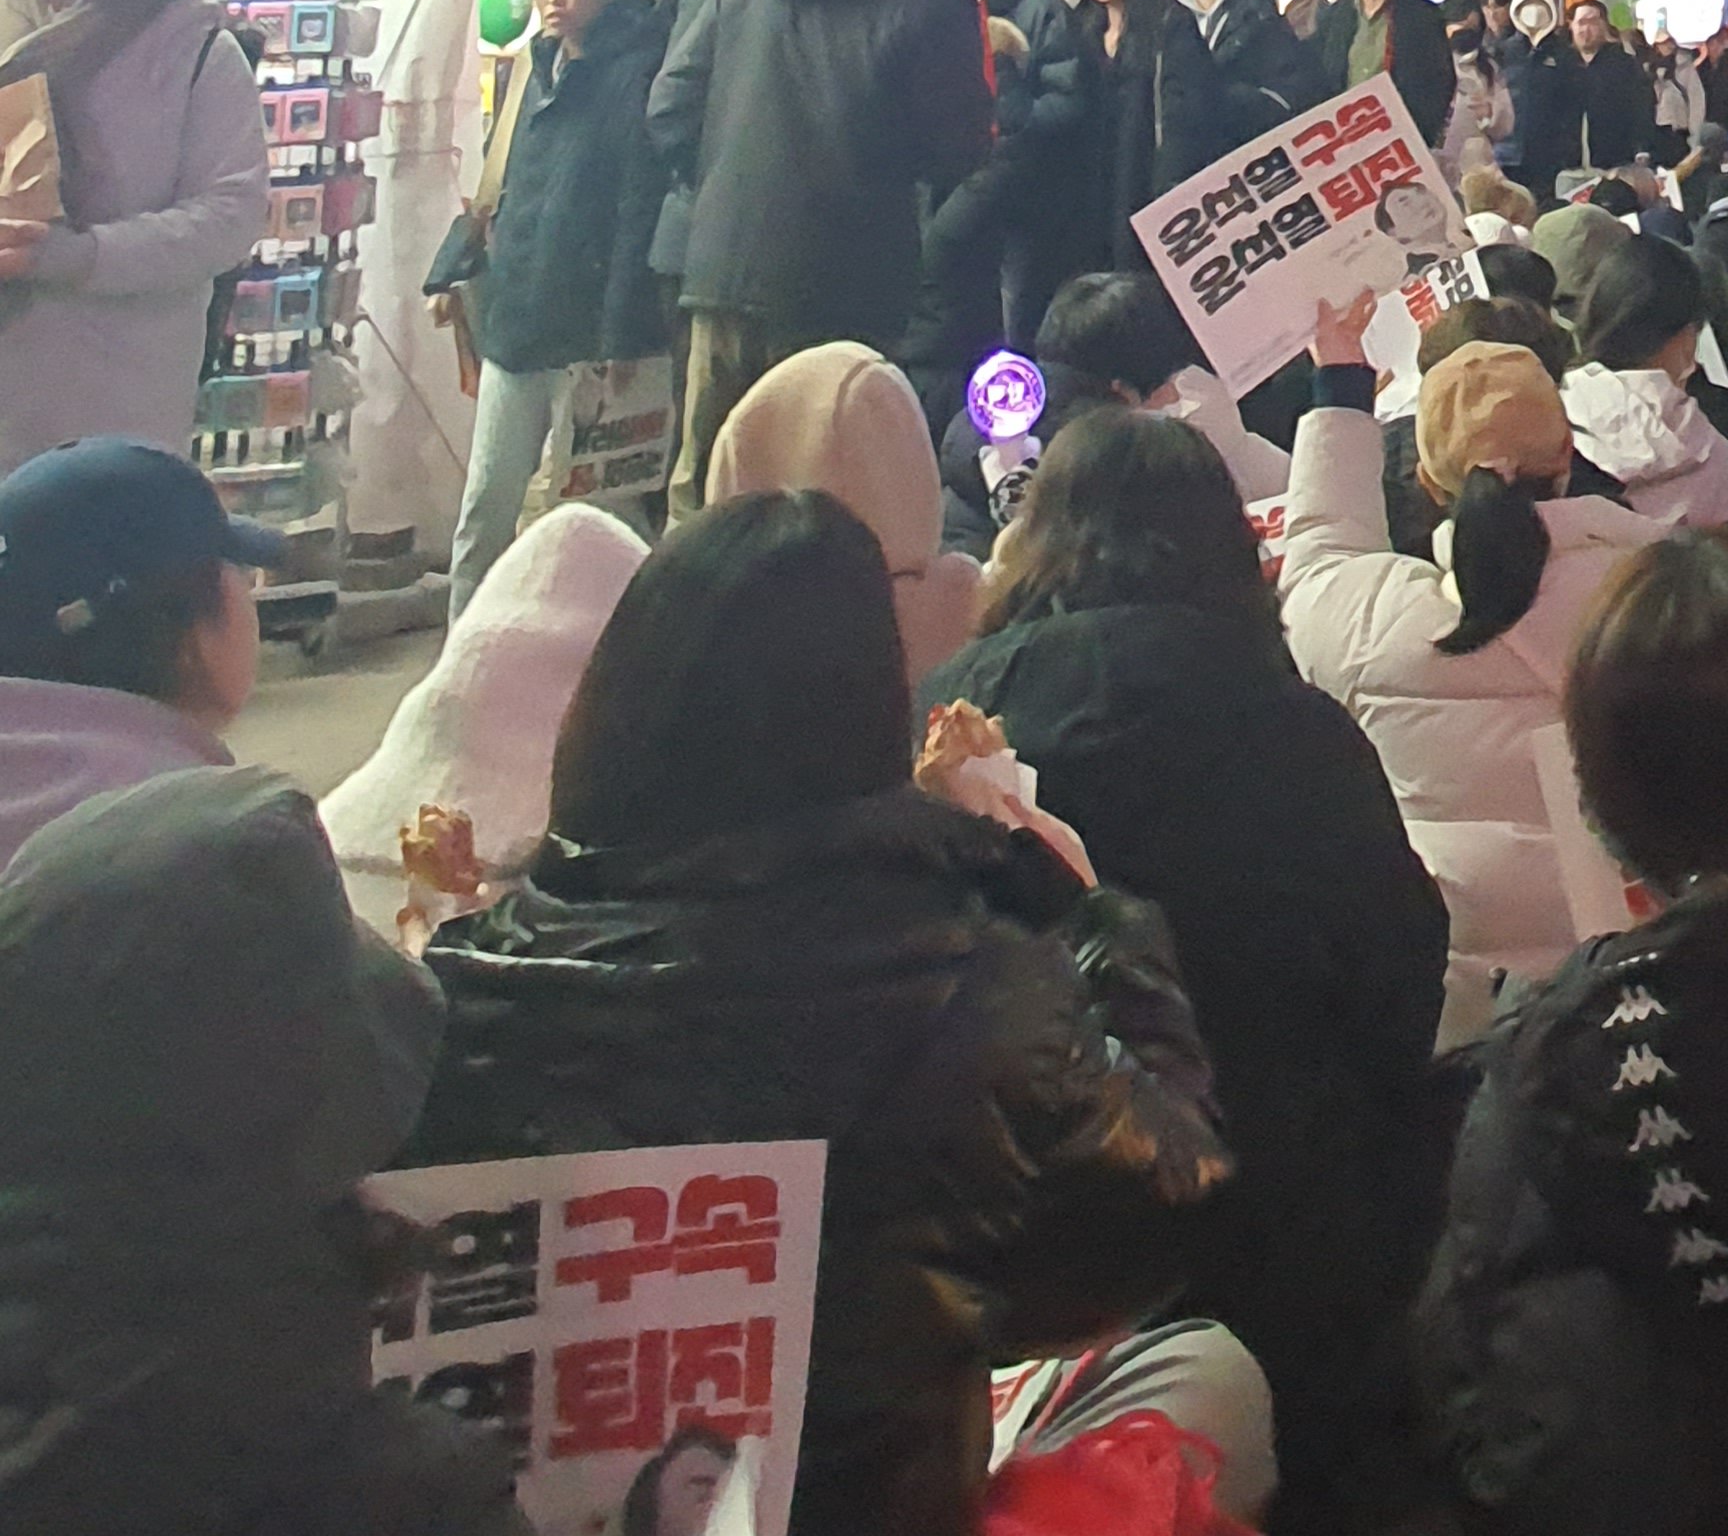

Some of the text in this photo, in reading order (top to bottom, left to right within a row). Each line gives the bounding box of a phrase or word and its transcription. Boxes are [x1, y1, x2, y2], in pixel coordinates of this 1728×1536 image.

[1291, 94, 1393, 168] 구속
[1318, 138, 1423, 222] 퇴진
[556, 1173, 782, 1304] 구속
[548, 1316, 777, 1460] 퇴진
